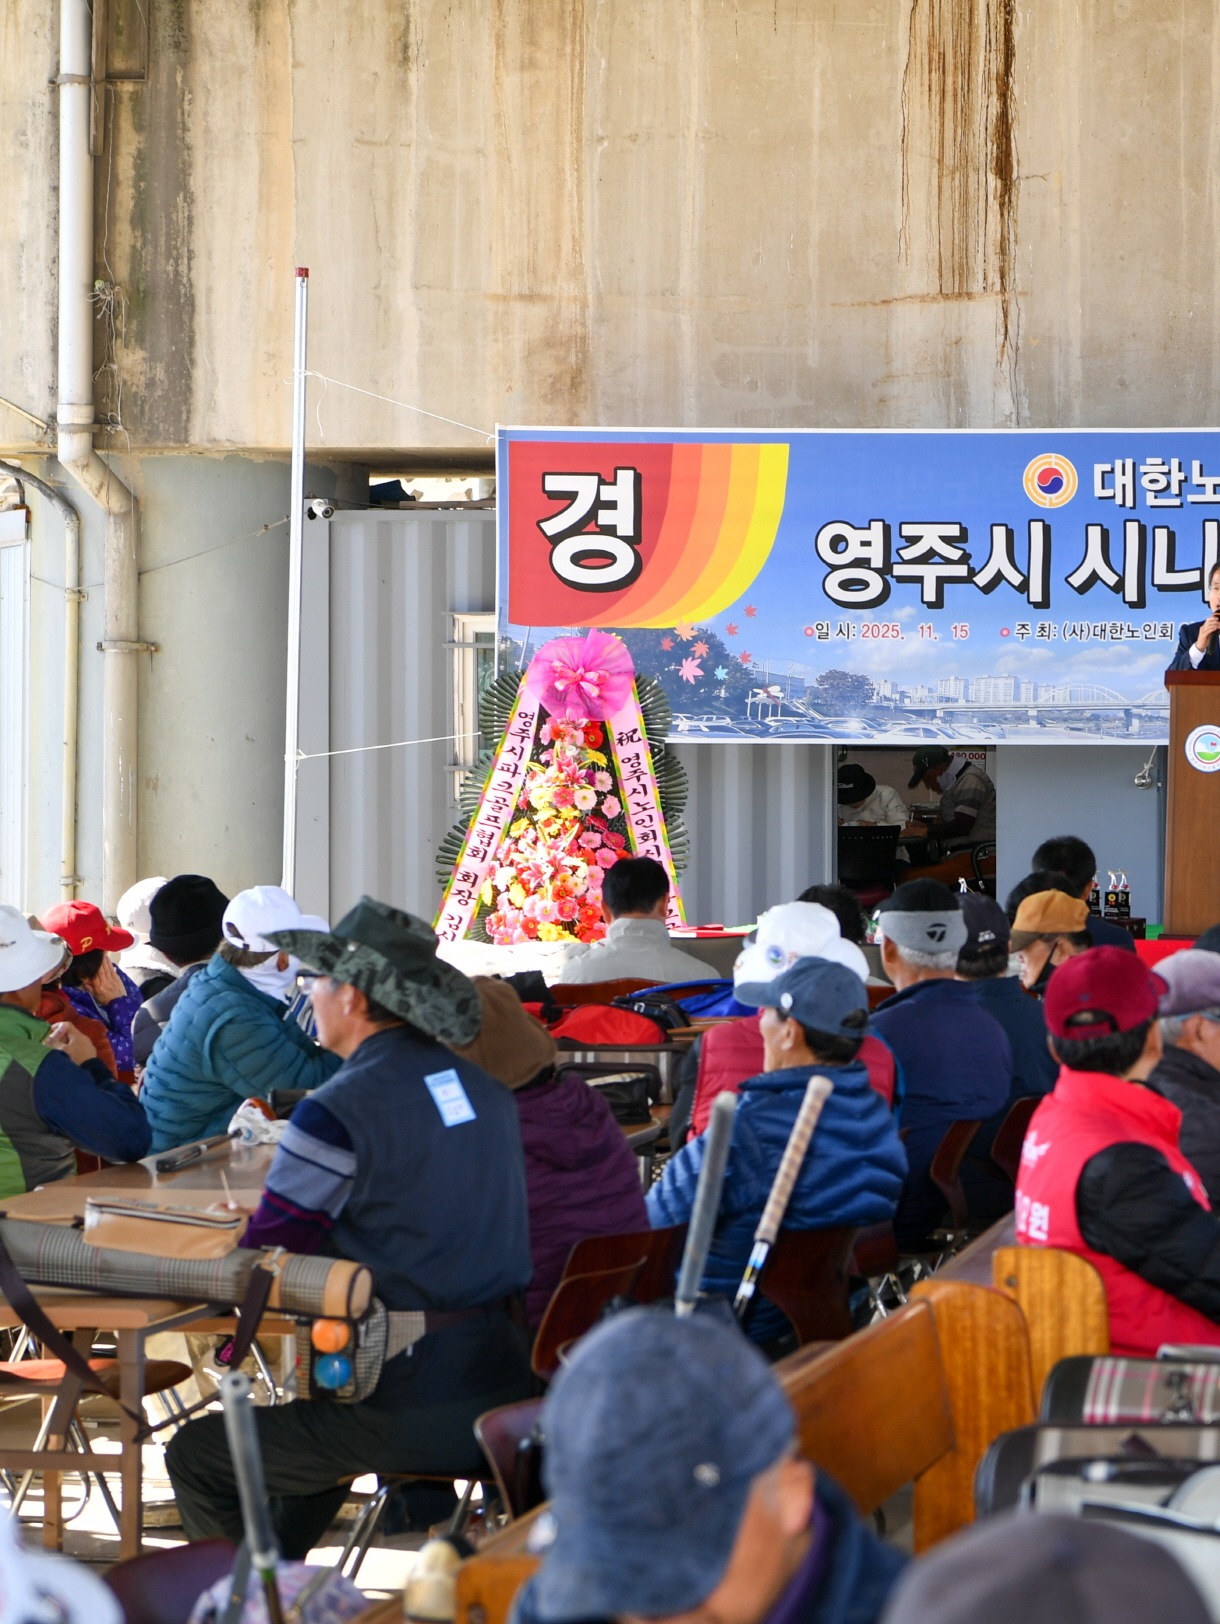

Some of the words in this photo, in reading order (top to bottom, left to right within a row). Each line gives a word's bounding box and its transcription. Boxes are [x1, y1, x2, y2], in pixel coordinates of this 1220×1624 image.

[536, 466, 643, 593] 경
[815, 518, 1051, 609] 영주시
[815, 622, 830, 640] 일
[835, 622, 857, 640] 시:
[861, 623, 905, 640] 2025.
[918, 623, 938, 640] 11.
[952, 624, 969, 639] 15
[1015, 623, 1031, 640] 주
[1036, 622, 1058, 640] 최:
[1062, 621, 1174, 641] (사)대한노인회
[615, 727, 643, 748] 祝
[466, 711, 536, 864] 영주시파크골프협회
[620, 752, 666, 866] 영주시노인회시
[450, 870, 480, 907] 회장
